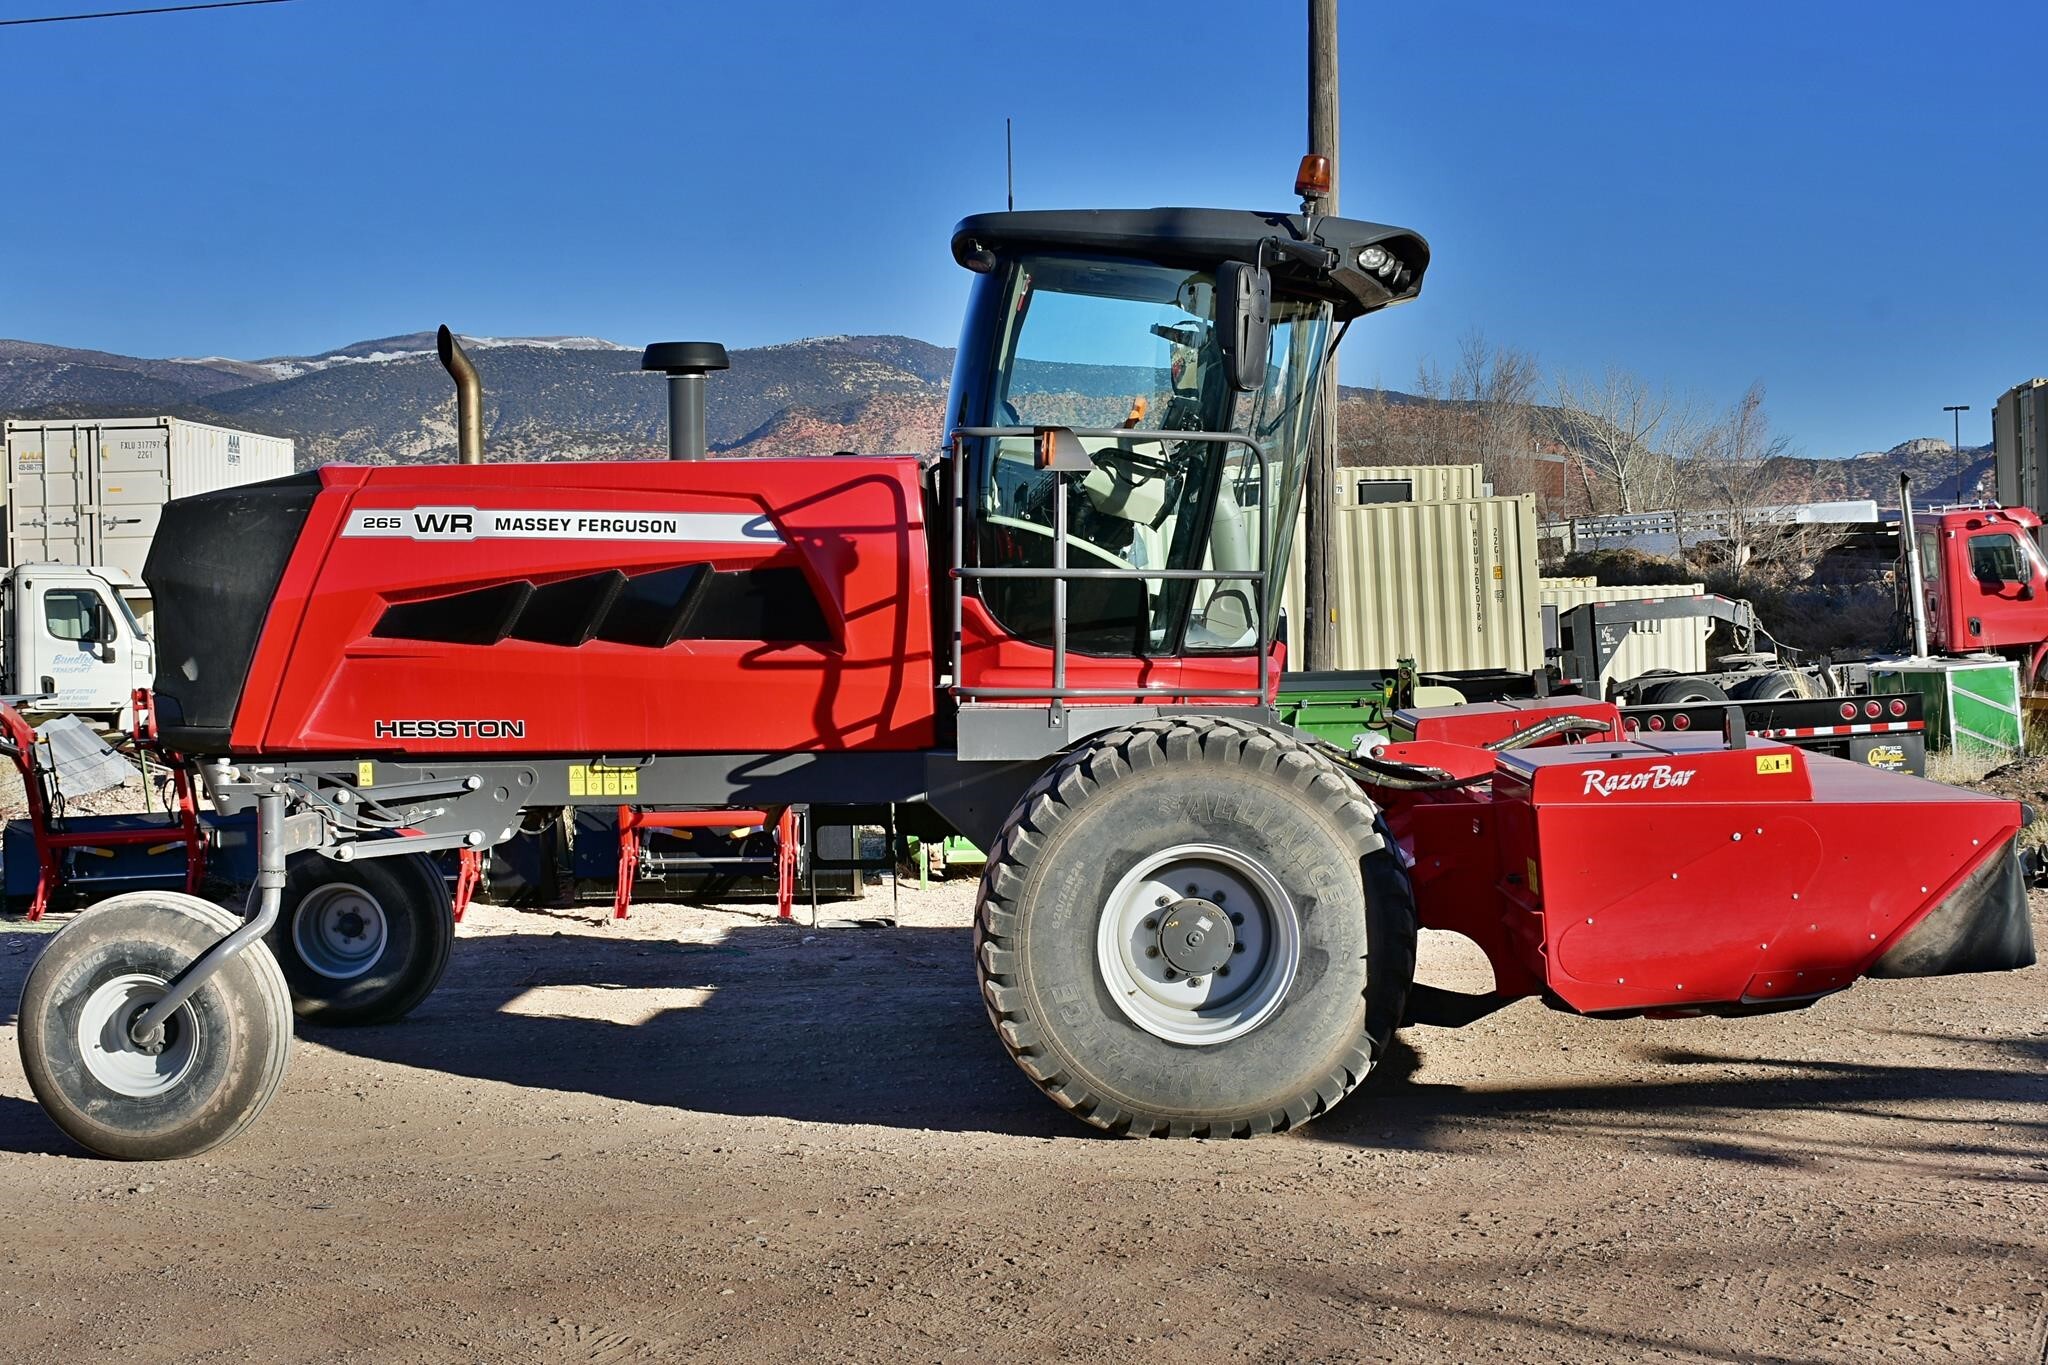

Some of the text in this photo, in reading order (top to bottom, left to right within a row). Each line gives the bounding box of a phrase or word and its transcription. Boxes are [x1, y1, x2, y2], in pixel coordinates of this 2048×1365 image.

[120, 441, 135, 450] FXLU
[137, 440, 160, 449] 317797
[137, 450, 152, 459] 22G1
[363, 513, 677, 534] 265 WR MASSEY FERGUSON
[1474, 567, 1482, 621] 205078
[1477, 623, 1482, 633] 6
[375, 720, 525, 738] HESSTON
[1581, 765, 1697, 797] RazorBar
